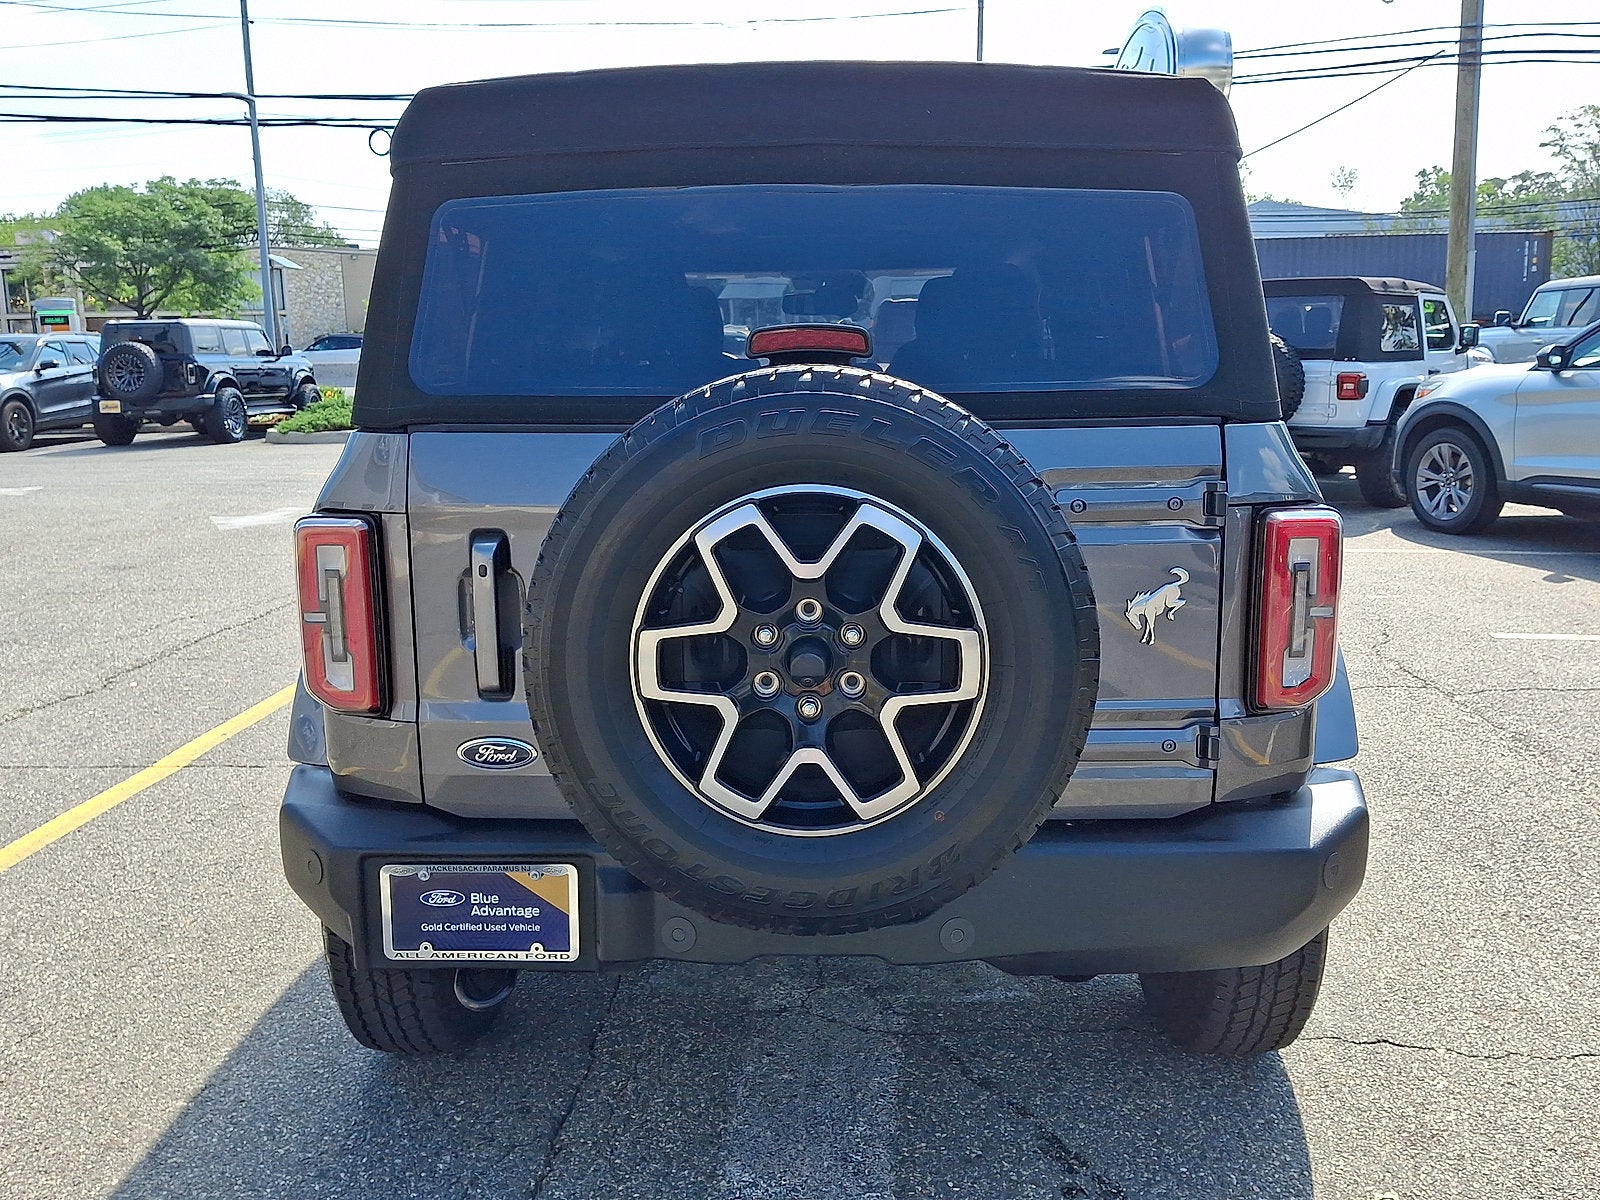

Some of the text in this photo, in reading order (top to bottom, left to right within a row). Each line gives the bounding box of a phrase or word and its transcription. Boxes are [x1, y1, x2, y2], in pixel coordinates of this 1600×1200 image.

[697, 408, 1001, 512] DUELER
[475, 744, 518, 763] Ford
[586, 780, 962, 909] BRIDGESTONE
[426, 865, 479, 873] HACKENSACK
[428, 892, 457, 904] Ford
[470, 892, 499, 904] Blue
[470, 905, 540, 918] Advantage
[421, 922, 541, 931] Gold Certified Used Vehicle
[430, 952, 519, 960] AMERICAN
